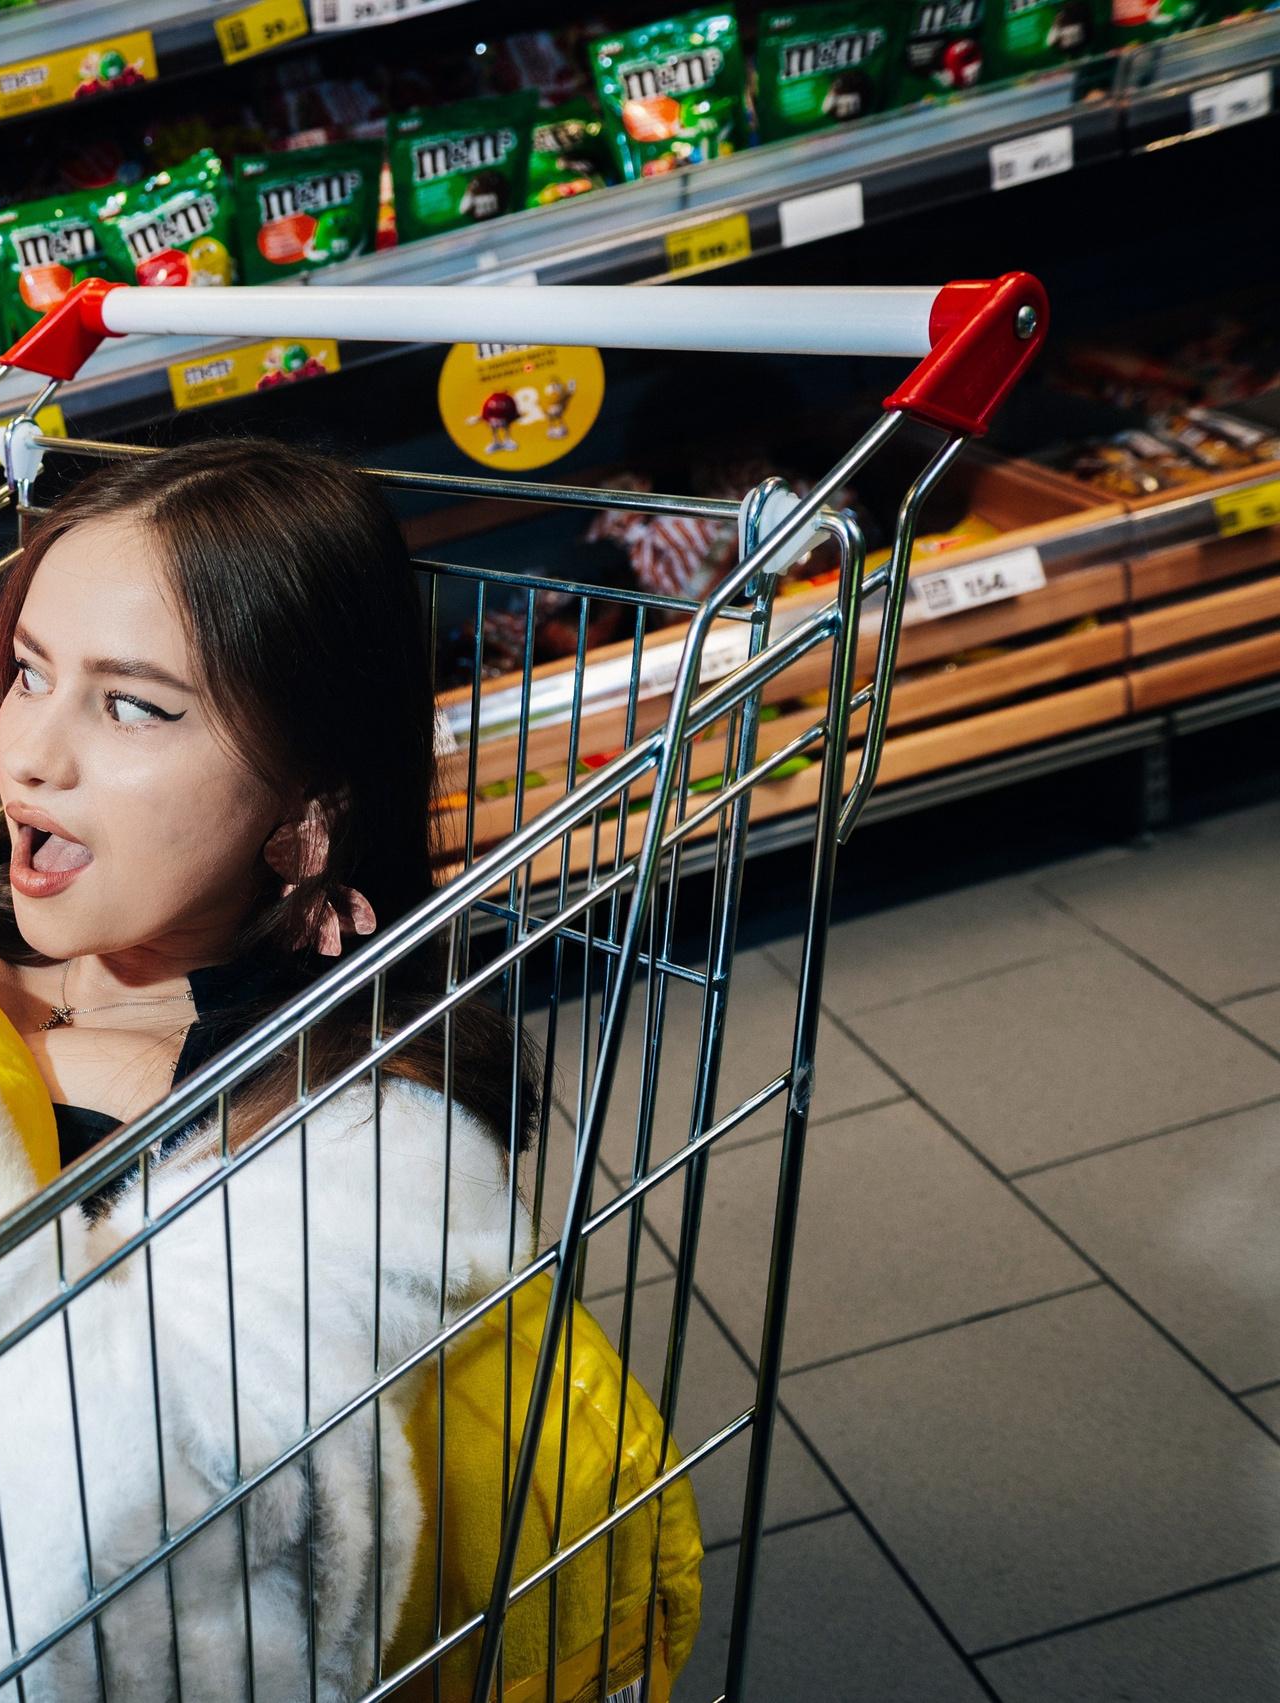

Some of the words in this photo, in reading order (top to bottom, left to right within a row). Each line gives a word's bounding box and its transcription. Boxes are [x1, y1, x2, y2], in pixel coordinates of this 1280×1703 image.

[624, 51, 720, 100] m&m's
[787, 30, 885, 78] m&m's
[414, 130, 514, 180] m&m's
[262, 171, 361, 221] m&m's
[19, 226, 100, 267] m&m
[129, 196, 216, 258] m&m's
